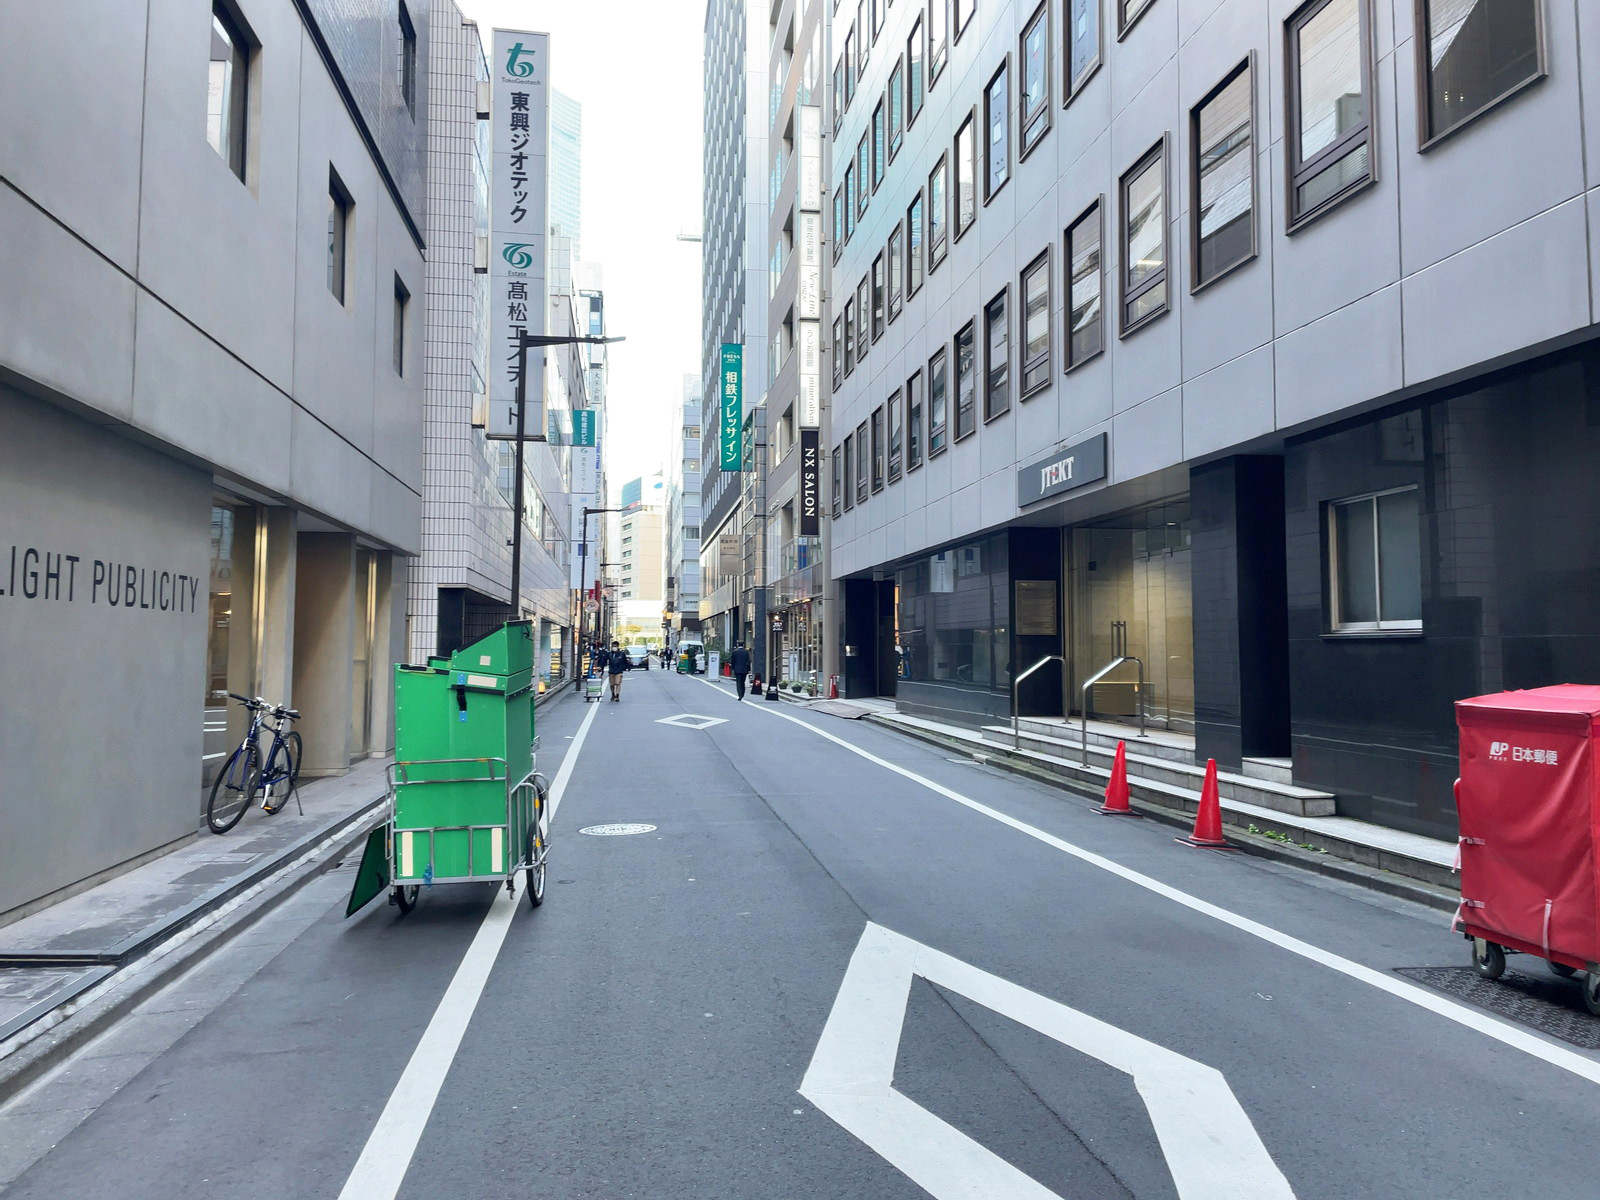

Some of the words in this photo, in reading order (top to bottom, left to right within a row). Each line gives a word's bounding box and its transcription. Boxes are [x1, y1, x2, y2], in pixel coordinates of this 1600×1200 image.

[501, 77, 541, 86] TokoGeotech
[510, 92, 530, 224] 東興ジオテック
[725, 371, 738, 462] 相鉄フレッサイン
[805, 448, 815, 467] NX
[1040, 456, 1074, 494] JTEKT
[805, 473, 815, 517] SALON
[92, 560, 199, 613] PUBLICITY
[1512, 746, 1558, 765] 日本郵便
